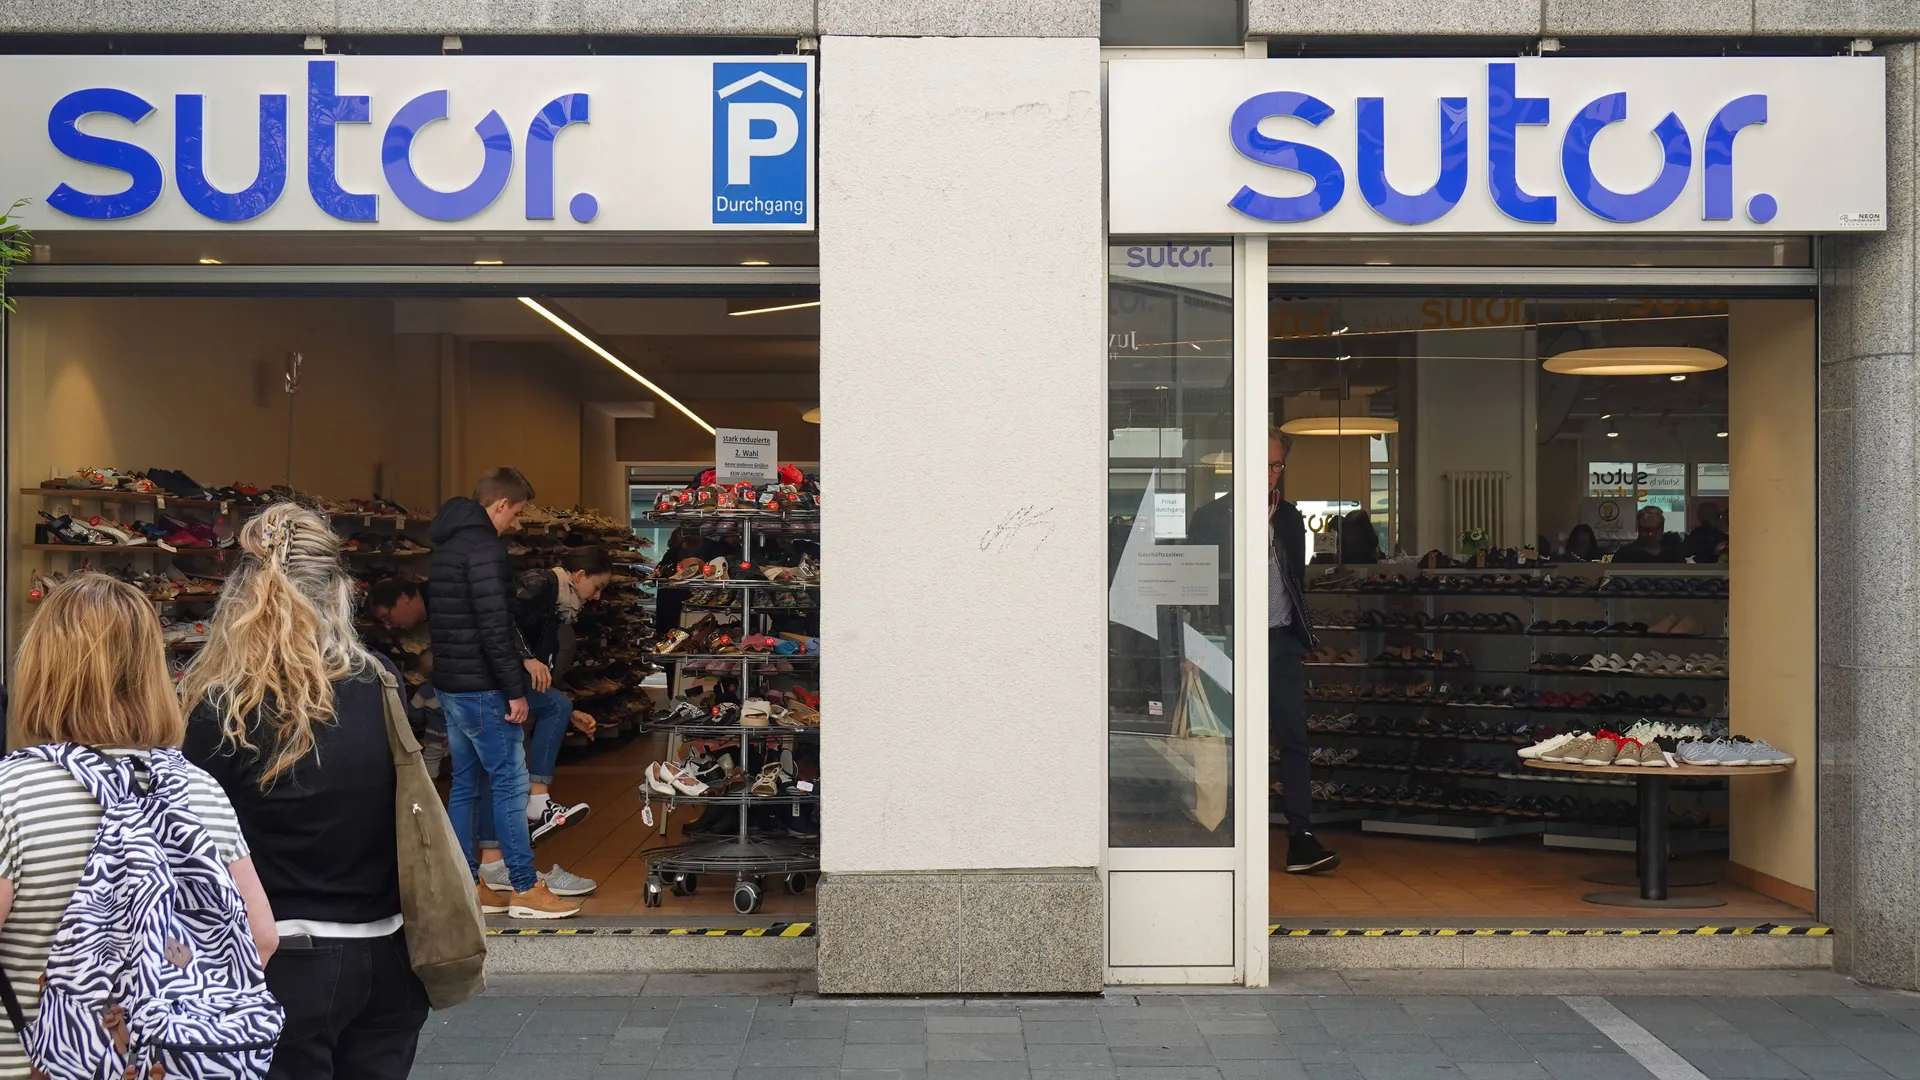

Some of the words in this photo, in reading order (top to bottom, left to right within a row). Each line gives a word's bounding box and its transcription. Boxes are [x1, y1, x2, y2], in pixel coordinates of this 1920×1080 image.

[46, 60, 598, 223] sutor.
[728, 103, 799, 185] P
[1228, 62, 1777, 225] sutor.
[716, 196, 803, 215] Durchgang
[1127, 242, 1213, 267] sutor.
[722, 435, 738, 443] stark
[739, 436, 771, 444] reduzierte
